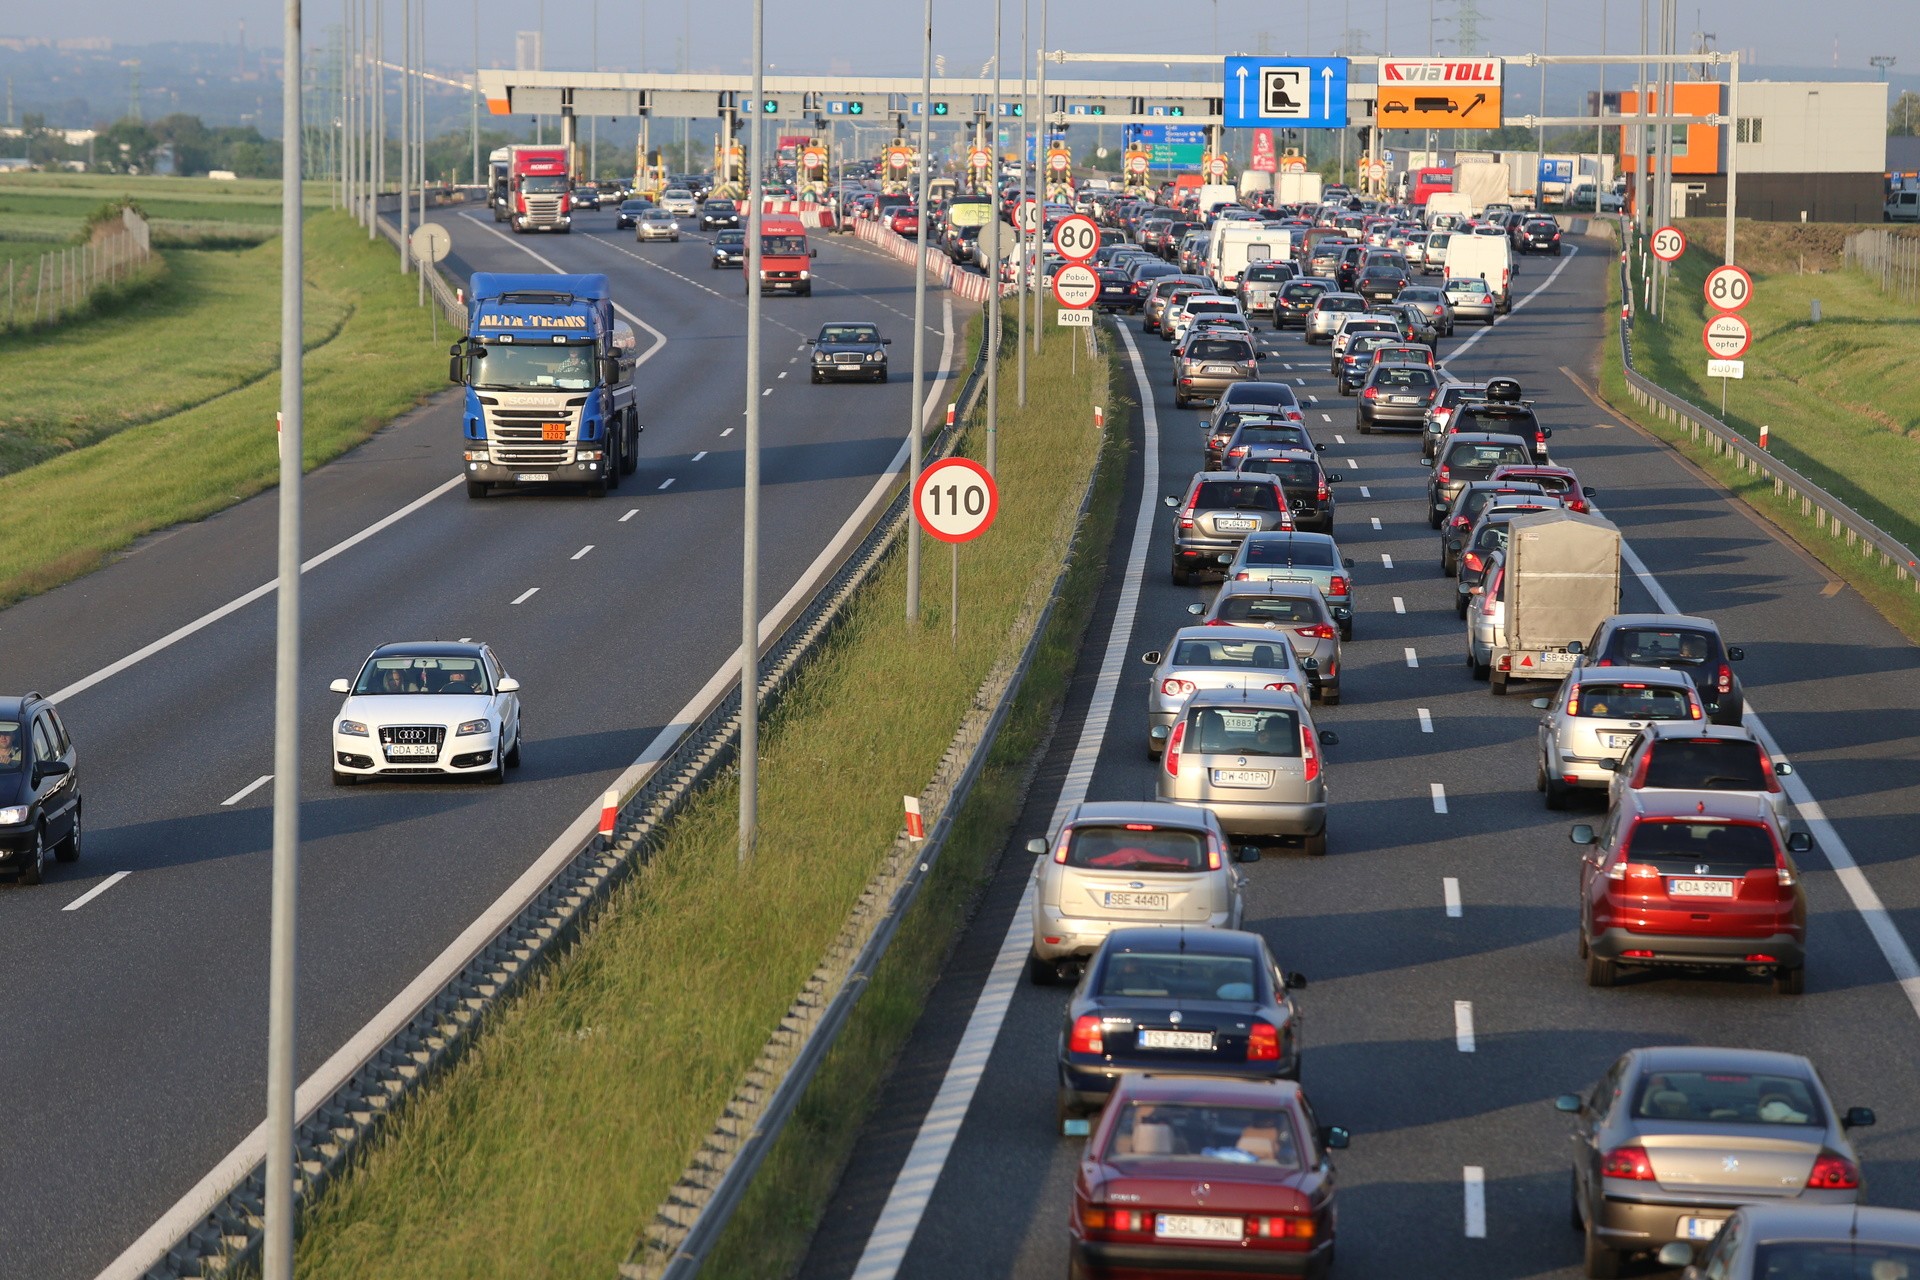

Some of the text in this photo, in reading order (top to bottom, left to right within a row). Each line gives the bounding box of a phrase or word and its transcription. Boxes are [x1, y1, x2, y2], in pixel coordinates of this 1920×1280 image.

[1544, 163, 1552, 174] P
[1061, 226, 1094, 249] 80
[1656, 235, 1681, 252] 50
[1712, 277, 1746, 300] 80
[509, 396, 556, 406] SCANIA
[929, 484, 985, 516] 110
[1225, 719, 1252, 728] 61883
[392, 745, 436, 755] GDA 3EA2
[1221, 771, 1235, 781] DW
[1677, 881, 1700, 892] KDA
[1111, 894, 1166, 906] SBE 44401
